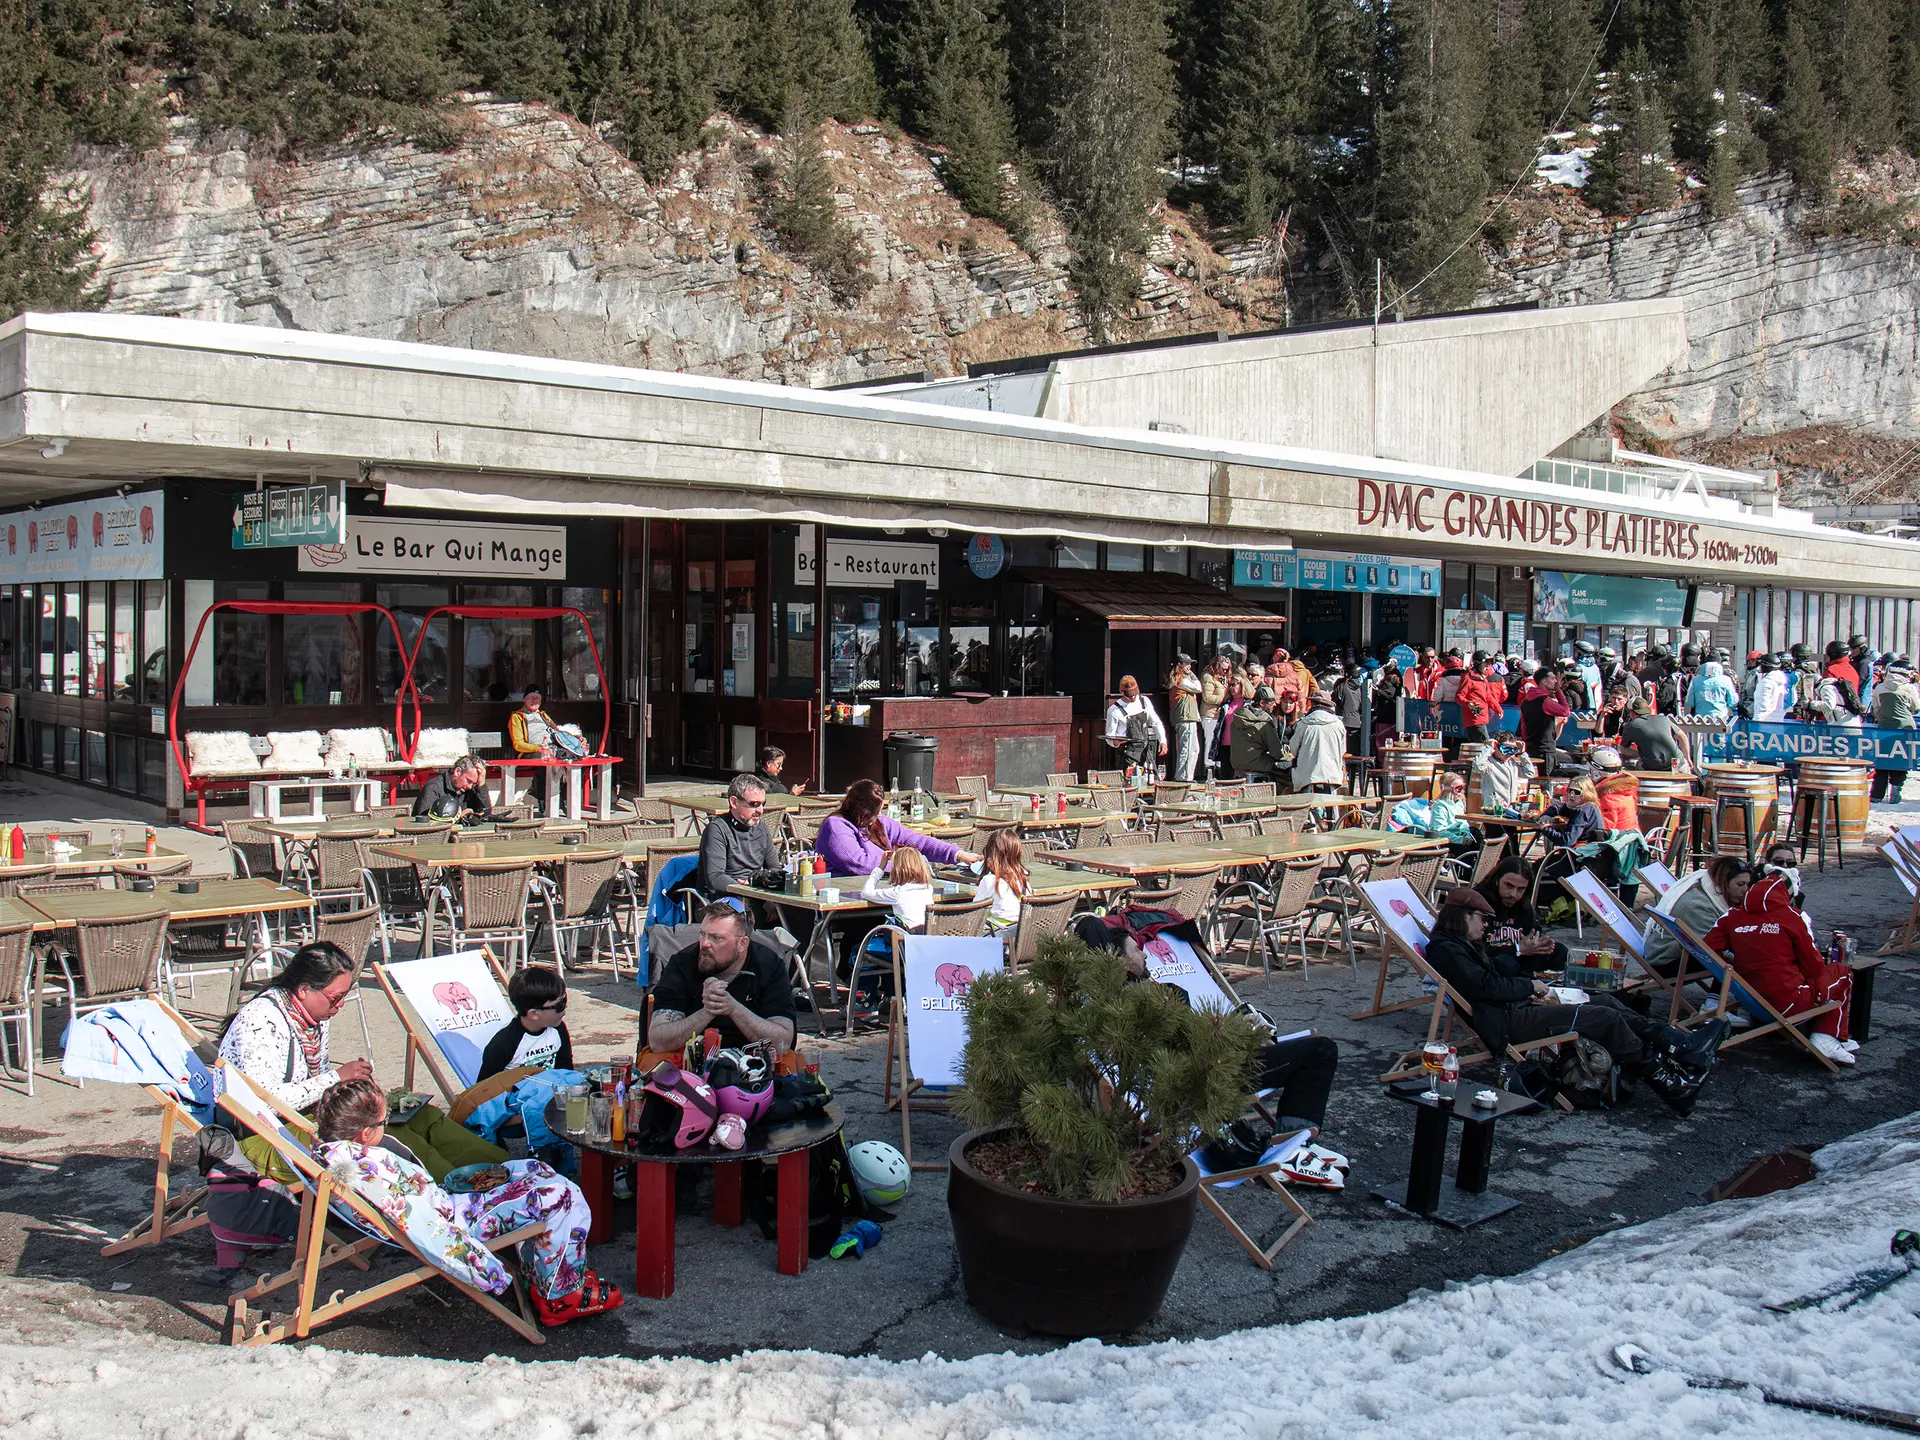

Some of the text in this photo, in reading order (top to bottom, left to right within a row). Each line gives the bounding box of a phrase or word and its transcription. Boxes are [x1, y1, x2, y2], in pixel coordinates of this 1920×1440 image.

[244, 493, 264, 506] POSTE DE
[271, 499, 286, 511] CAISSE
[244, 506, 263, 519] SECOURS
[1358, 479, 1778, 566] DMC GRANDES PLATIERES 1600M-2500M
[357, 535, 562, 571] Le Bar Qui Mange
[1236, 551, 1296, 564] ACCES TOILETTES
[798, 553, 829, 570] Ba
[846, 555, 936, 576] Restaurant
[1303, 560, 1327, 570] ECOLES
[1354, 554, 1391, 566] ACCES DMC
[1304, 570, 1327, 580] DE SKI
[1572, 589, 1587, 597] FLAINE
[1732, 730, 1849, 756] GRANDES
[1298, 1167, 1329, 1180] ATOMIC
[576, 1304, 604, 1313] TECNICA
